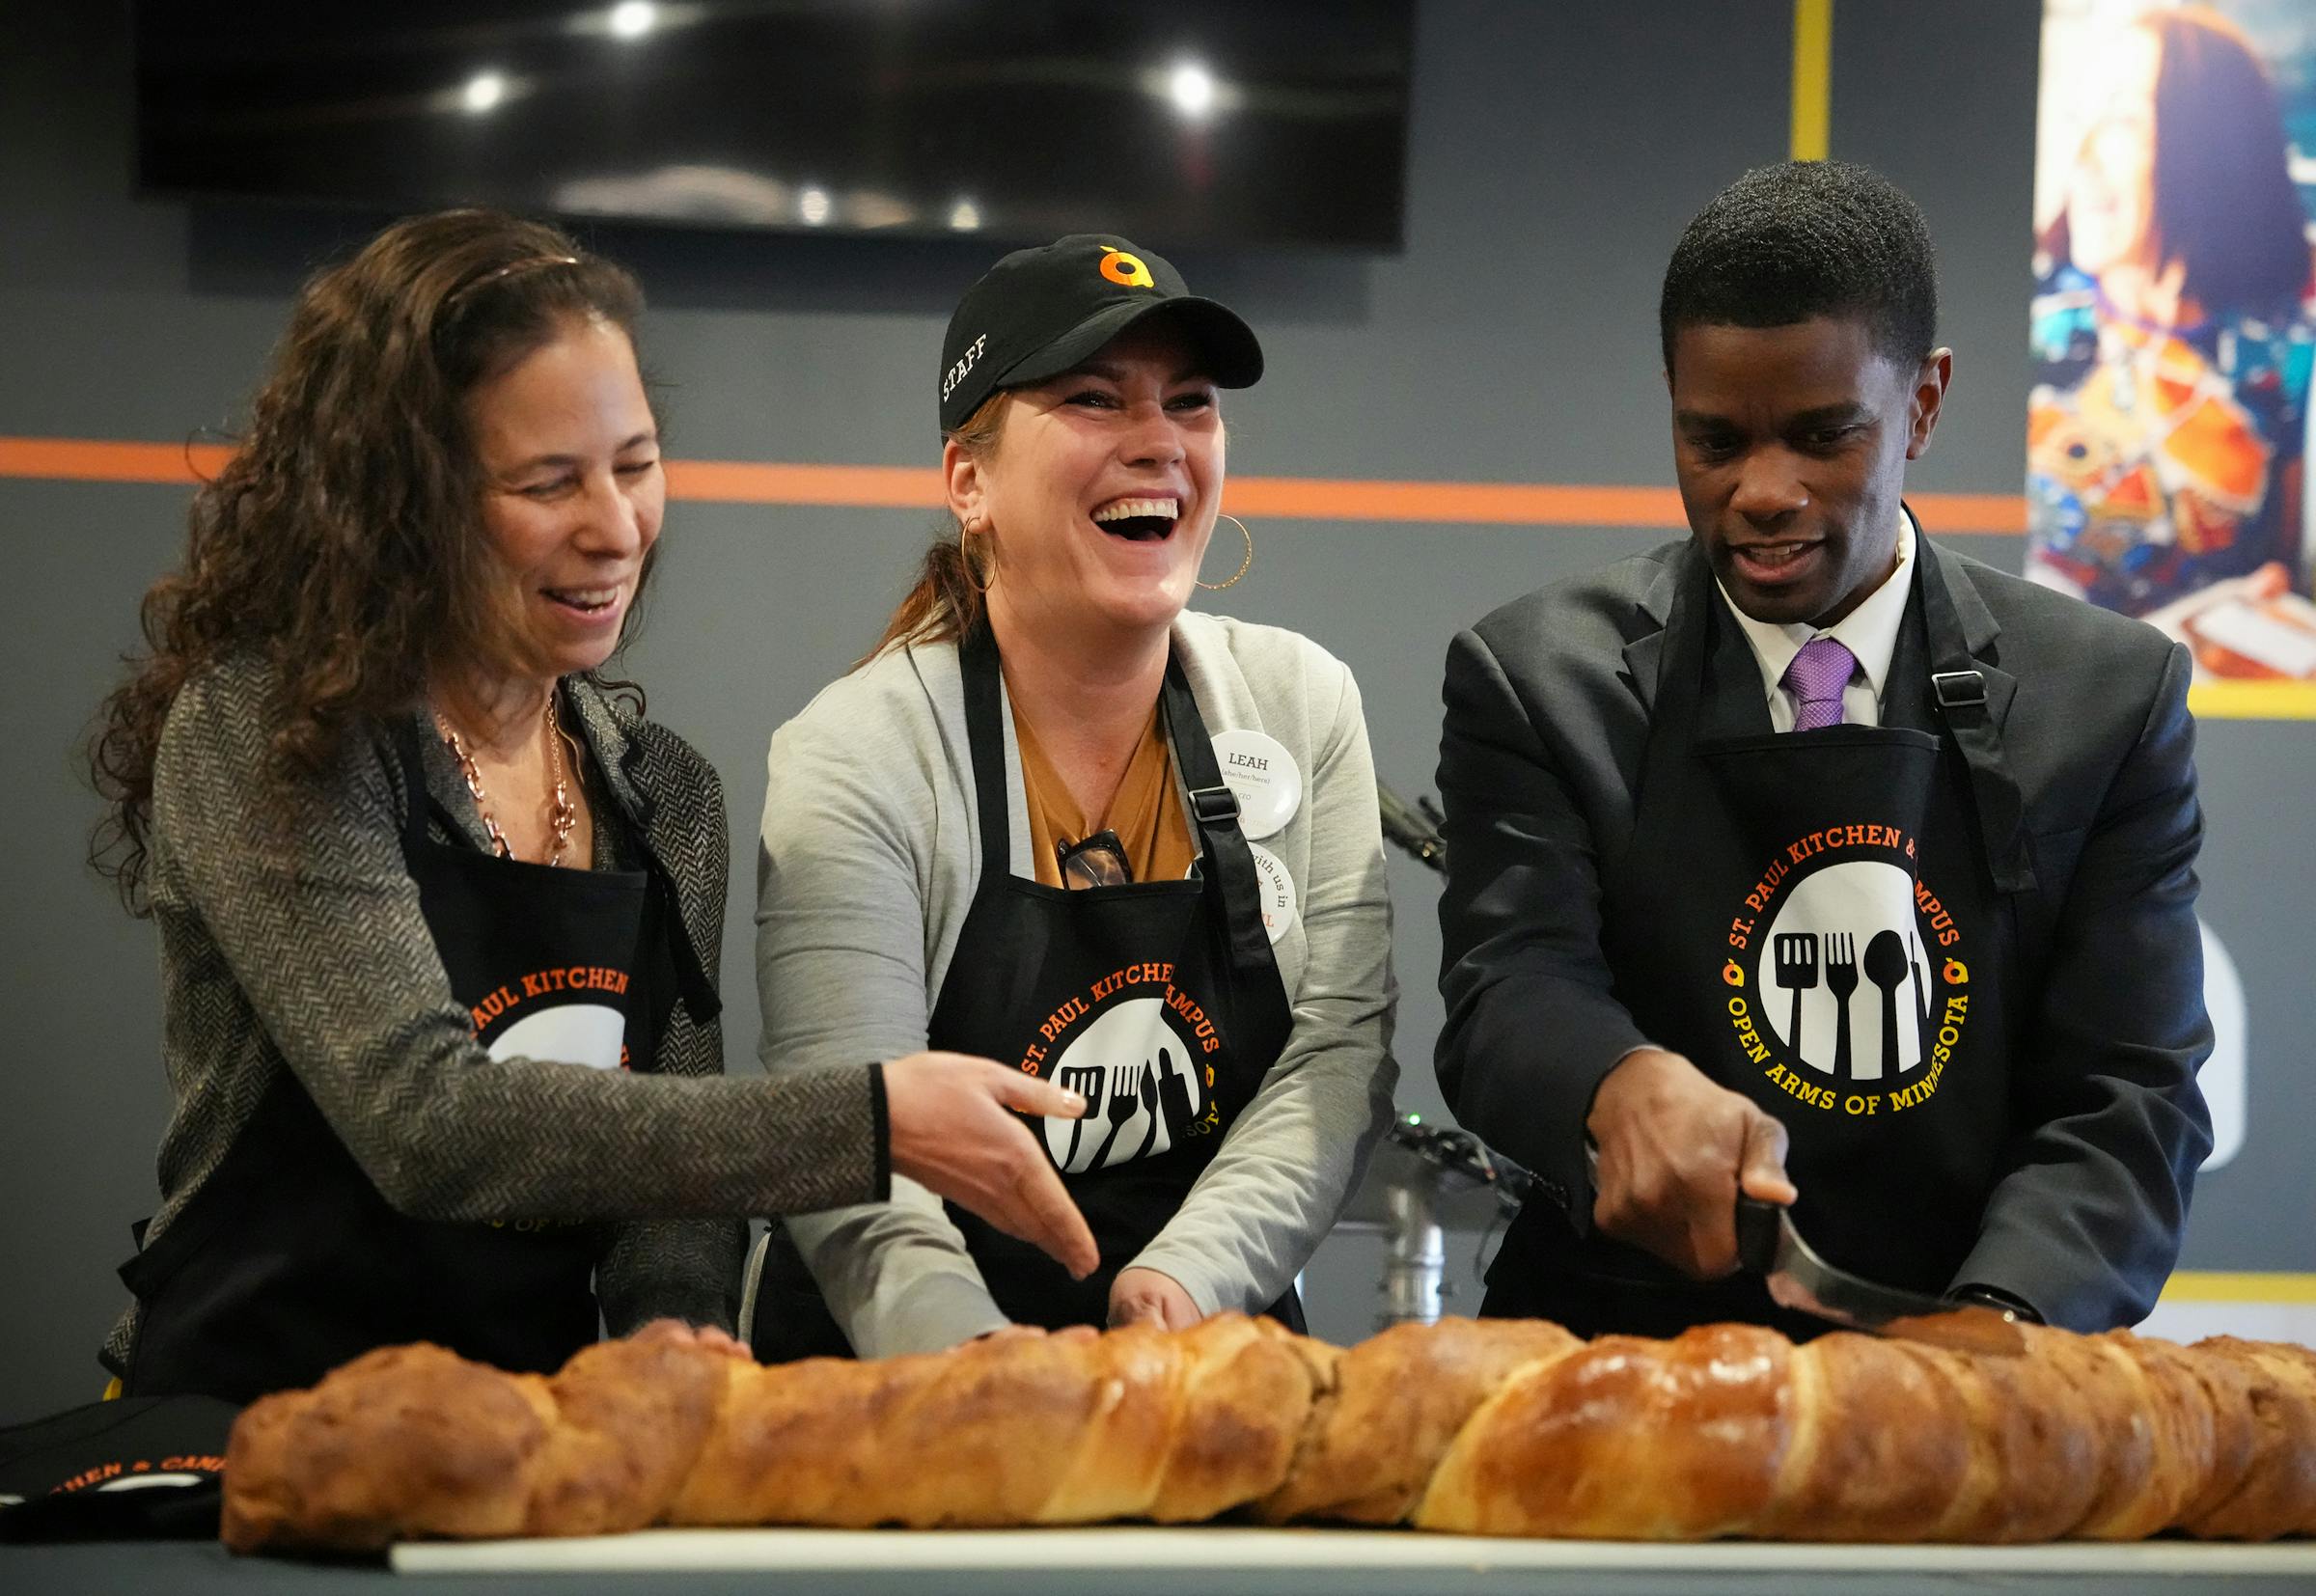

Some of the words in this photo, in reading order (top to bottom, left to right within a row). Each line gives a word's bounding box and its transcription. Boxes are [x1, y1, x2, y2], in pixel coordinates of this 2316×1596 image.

[943, 333, 987, 402] STAFF
[1228, 753, 1269, 771] LEAH
[1273, 874, 1284, 892] us
[1277, 895, 1289, 909] in
[1729, 917, 1755, 950] ST.
[1745, 859, 1788, 913] PAUL
[1786, 824, 1901, 864] KITCHEN
[1914, 879, 1961, 947] MPUS
[470, 986, 520, 1040] AUL
[520, 967, 629, 998] KITCHEN
[1021, 1044, 1048, 1076] ST.
[1039, 997, 1090, 1043] PAUL
[1089, 963, 1174, 1002] KITCHE
[1165, 983, 1220, 1053] AMPUS
[1728, 996, 1771, 1064] OPEN
[1764, 1062, 1836, 1111] ARMS
[1844, 1095, 1881, 1115] OF
